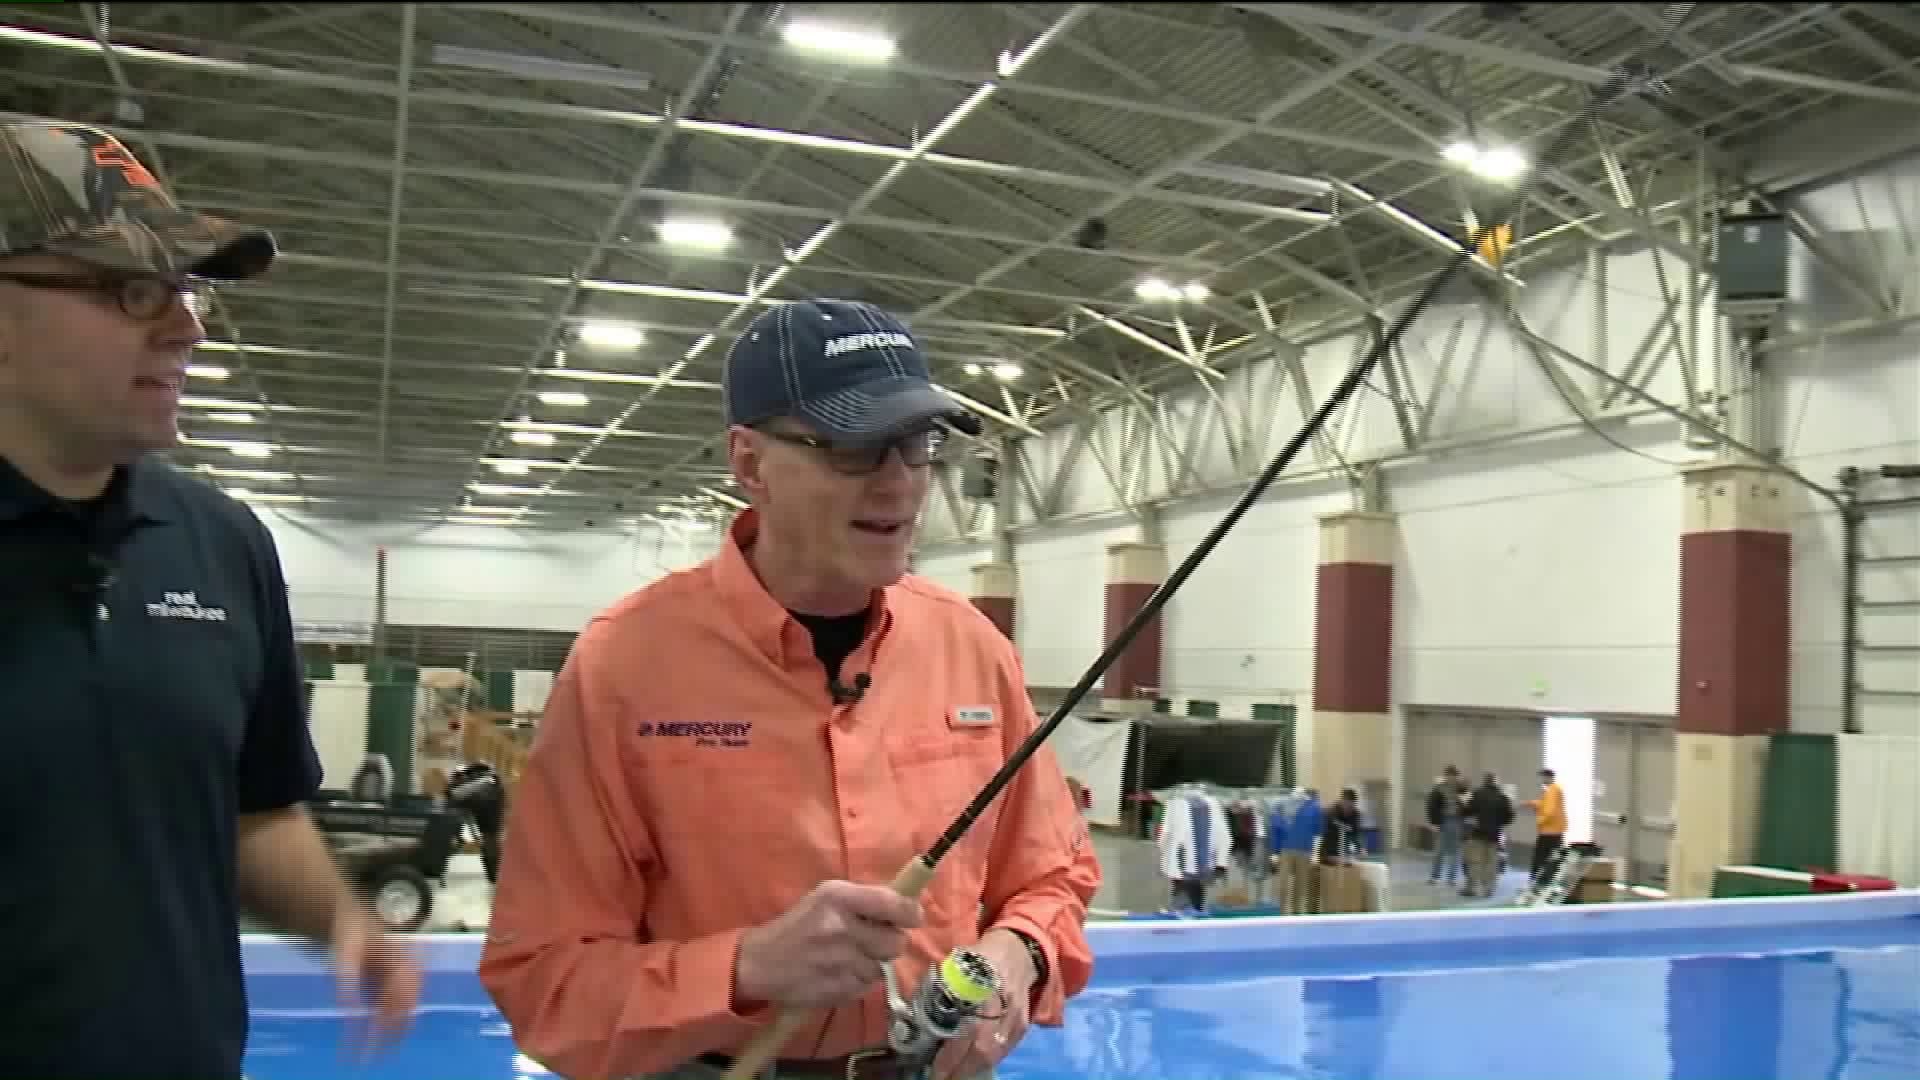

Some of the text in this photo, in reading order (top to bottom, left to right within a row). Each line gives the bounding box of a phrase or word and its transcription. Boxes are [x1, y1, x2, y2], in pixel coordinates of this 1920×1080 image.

[164, 590, 196, 604] real
[145, 602, 226, 620] milwaukee
[656, 721, 753, 736] MERCURY
